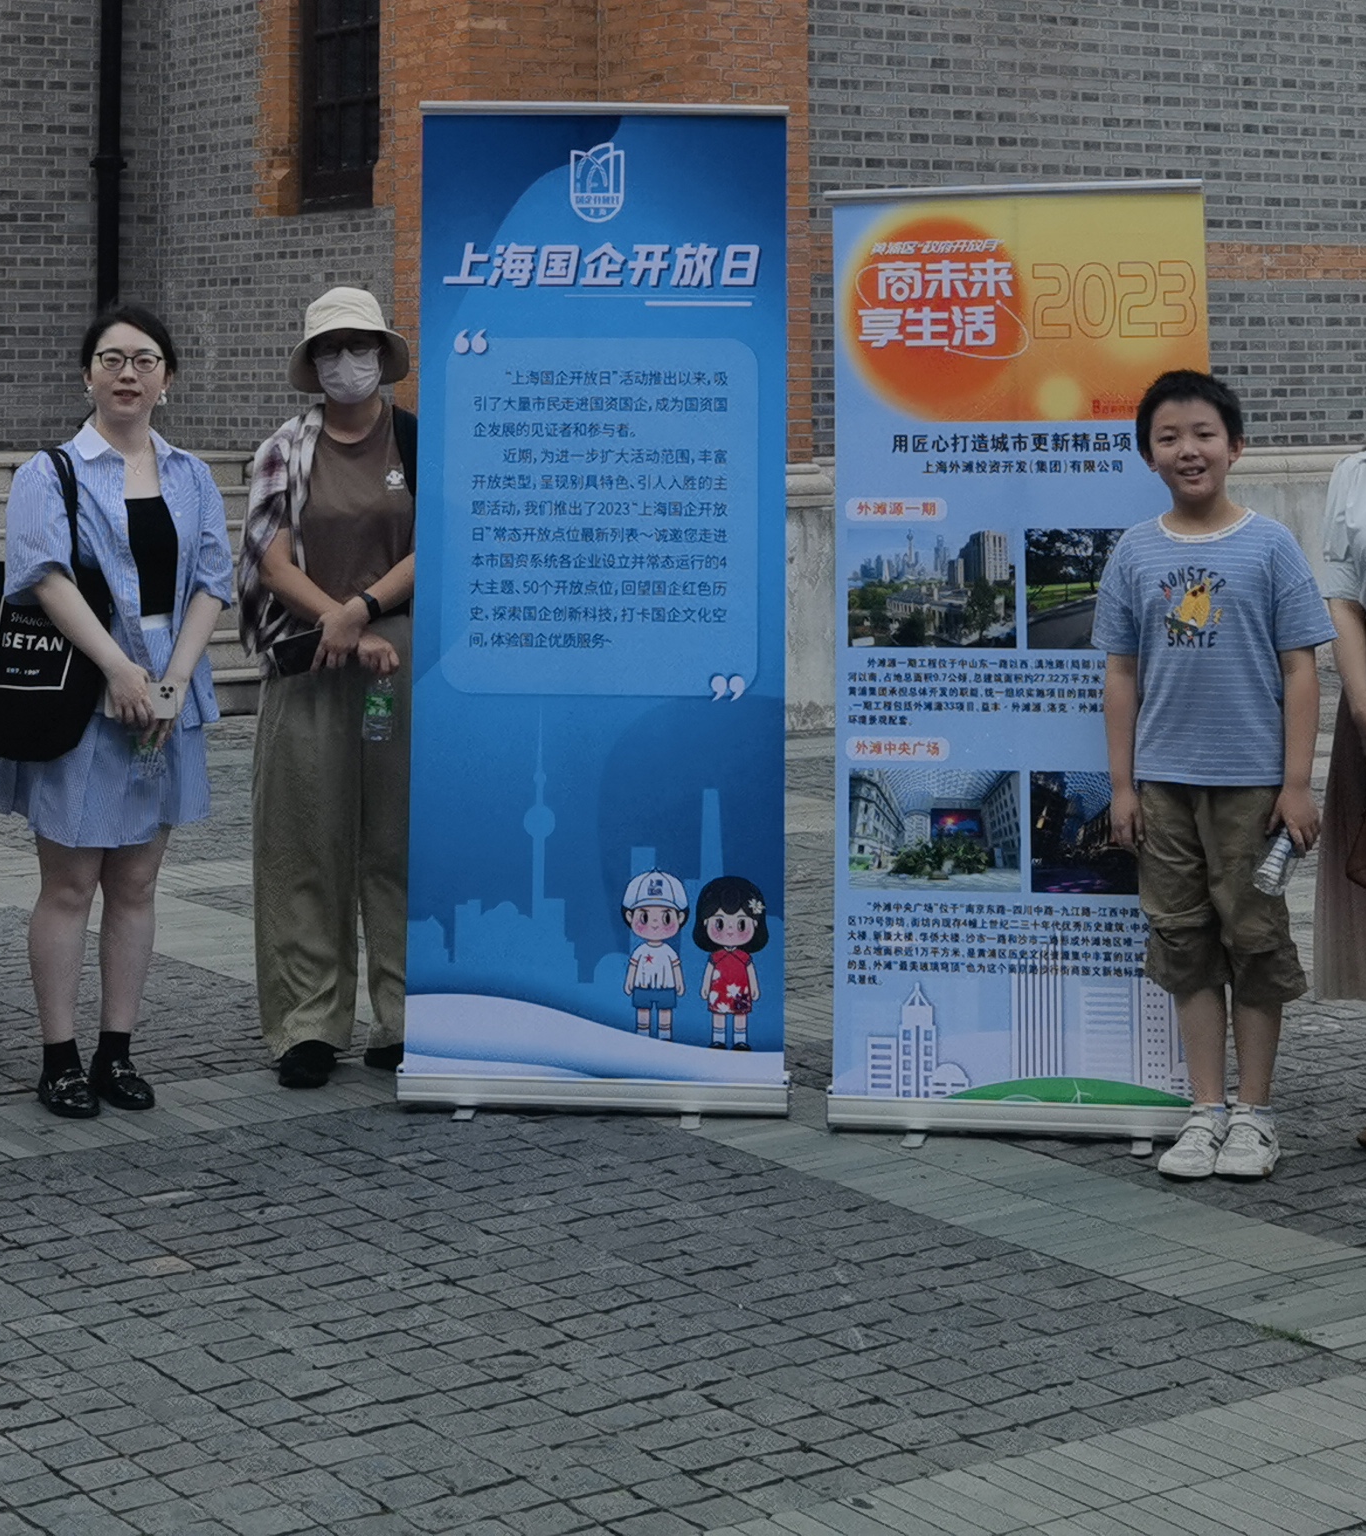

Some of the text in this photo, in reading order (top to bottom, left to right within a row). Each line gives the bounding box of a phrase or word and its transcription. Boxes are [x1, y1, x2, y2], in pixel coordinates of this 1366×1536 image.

[443, 241, 761, 288] 上海国企开放日
[877, 258, 1014, 302] 商未来
[1032, 260, 1197, 340] 2023
[857, 305, 996, 349] 享生活
[892, 432, 1132, 454] 用匠心打造城市更新精品项
[857, 501, 937, 517] 外滩源一期
[1158, 566, 1227, 594] MONSTER
[1, 631, 65, 652] ISETAN
[1167, 630, 1219, 649] SKATE
[855, 740, 941, 757] 外滩中央广场
